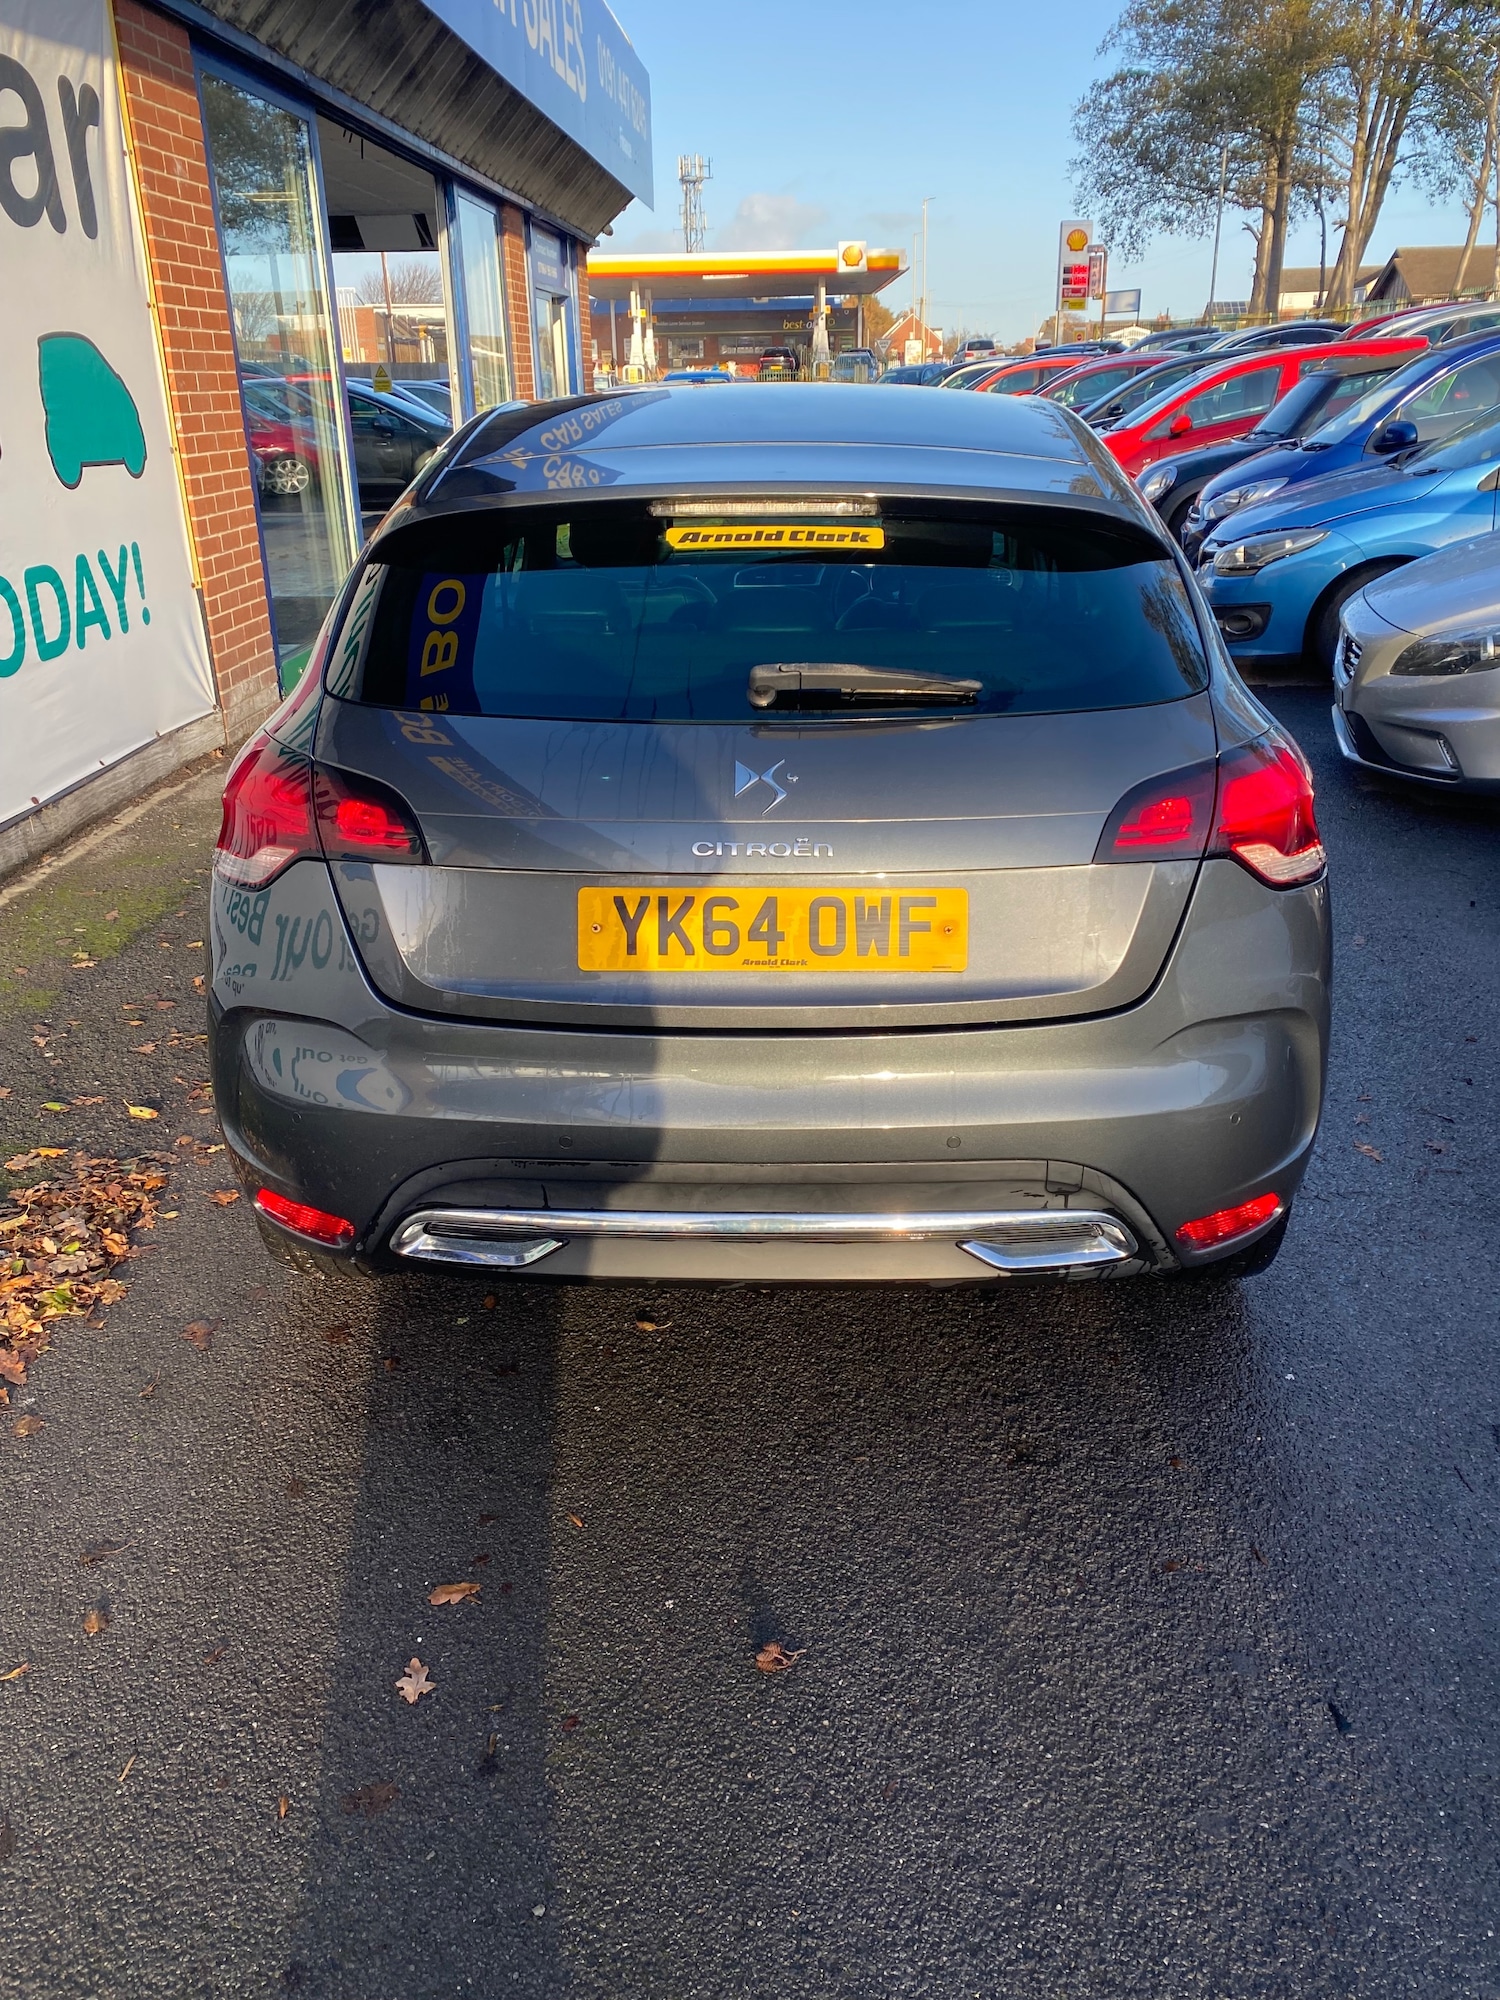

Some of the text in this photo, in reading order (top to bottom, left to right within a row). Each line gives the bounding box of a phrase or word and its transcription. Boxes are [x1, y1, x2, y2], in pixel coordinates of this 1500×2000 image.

[783, 319, 815, 329] best-o
[678, 530, 870, 543] Arnold Clark
[613, 896, 937, 957] YK64 OWF
